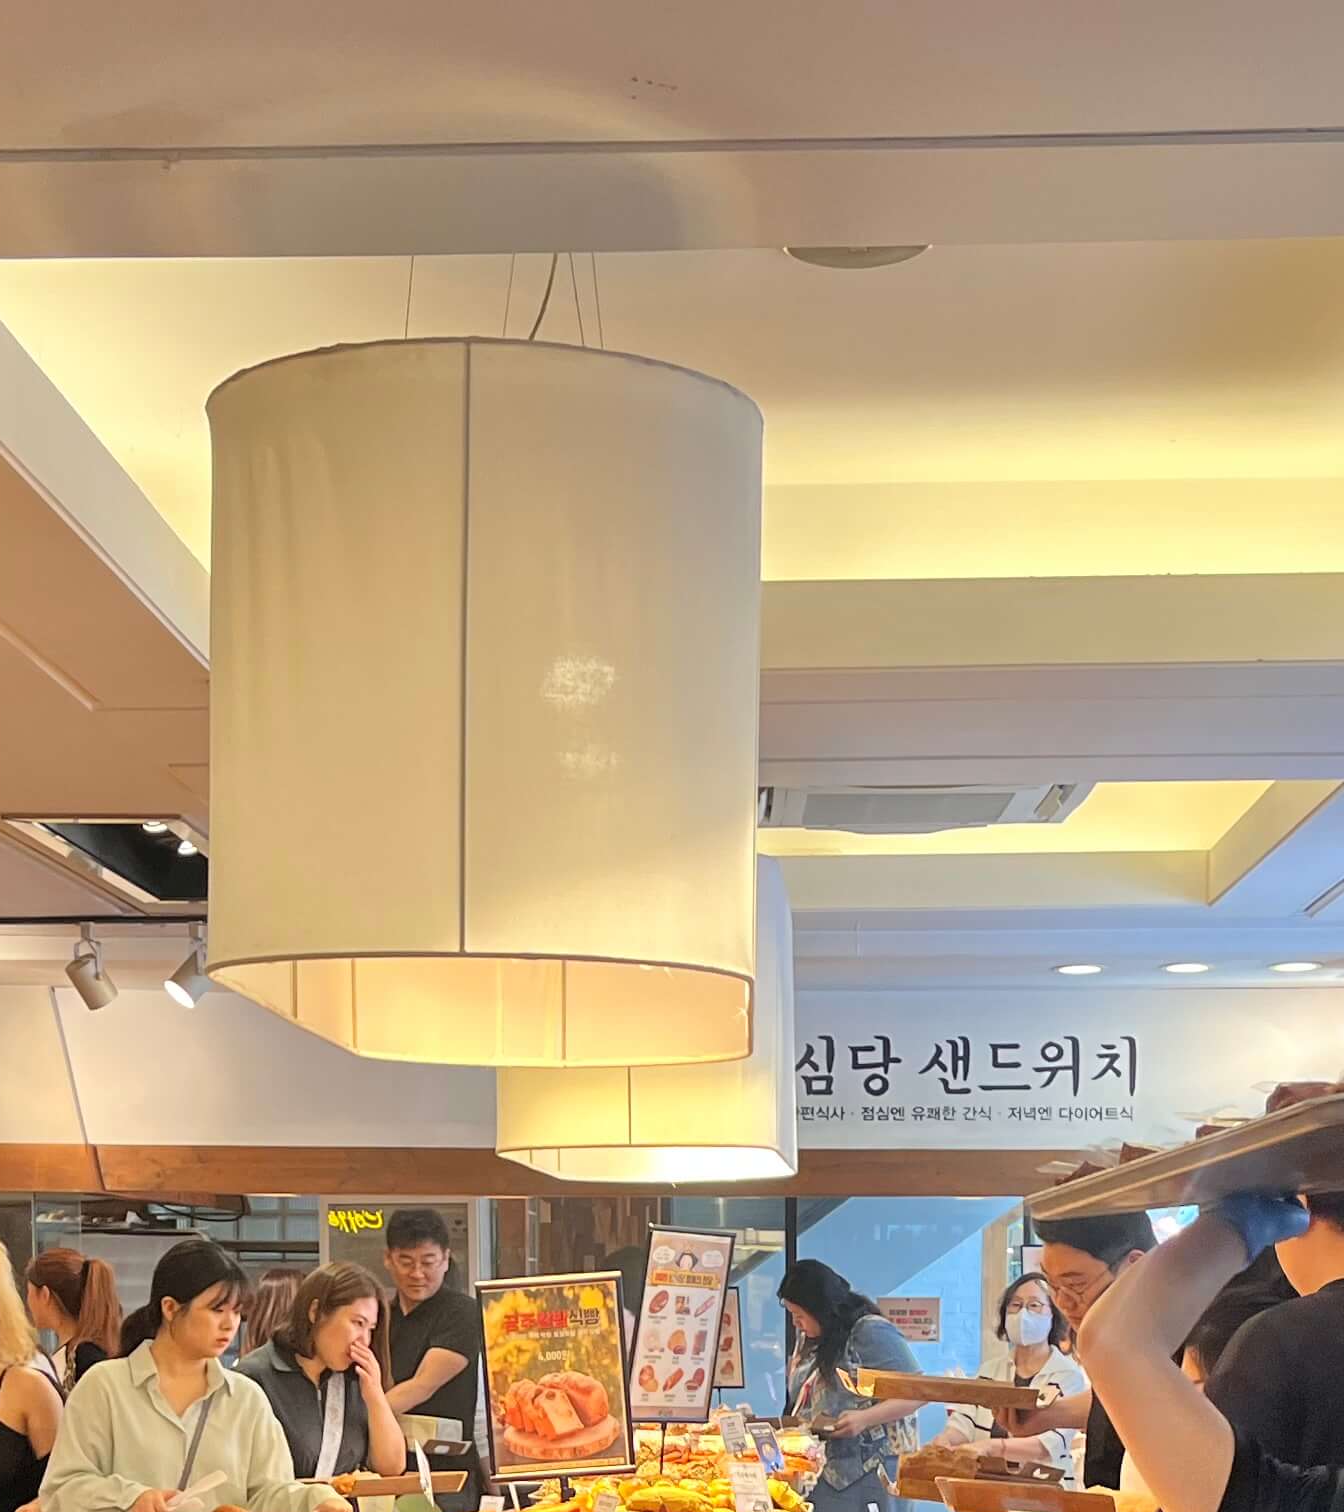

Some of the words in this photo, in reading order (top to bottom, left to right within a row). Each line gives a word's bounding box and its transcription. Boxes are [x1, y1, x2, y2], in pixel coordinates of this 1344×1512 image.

[794, 1035, 903, 1098] 심당
[917, 1035, 1137, 1097] 샌드위치
[796, 1106, 846, 1122] 편식사
[861, 1106, 905, 1122] 점심엔
[911, 1106, 957, 1122] 유쾌한
[962, 1106, 993, 1122] 간식
[1007, 1106, 1053, 1122] 저녁엔
[1058, 1106, 1134, 1122] 다이어트식
